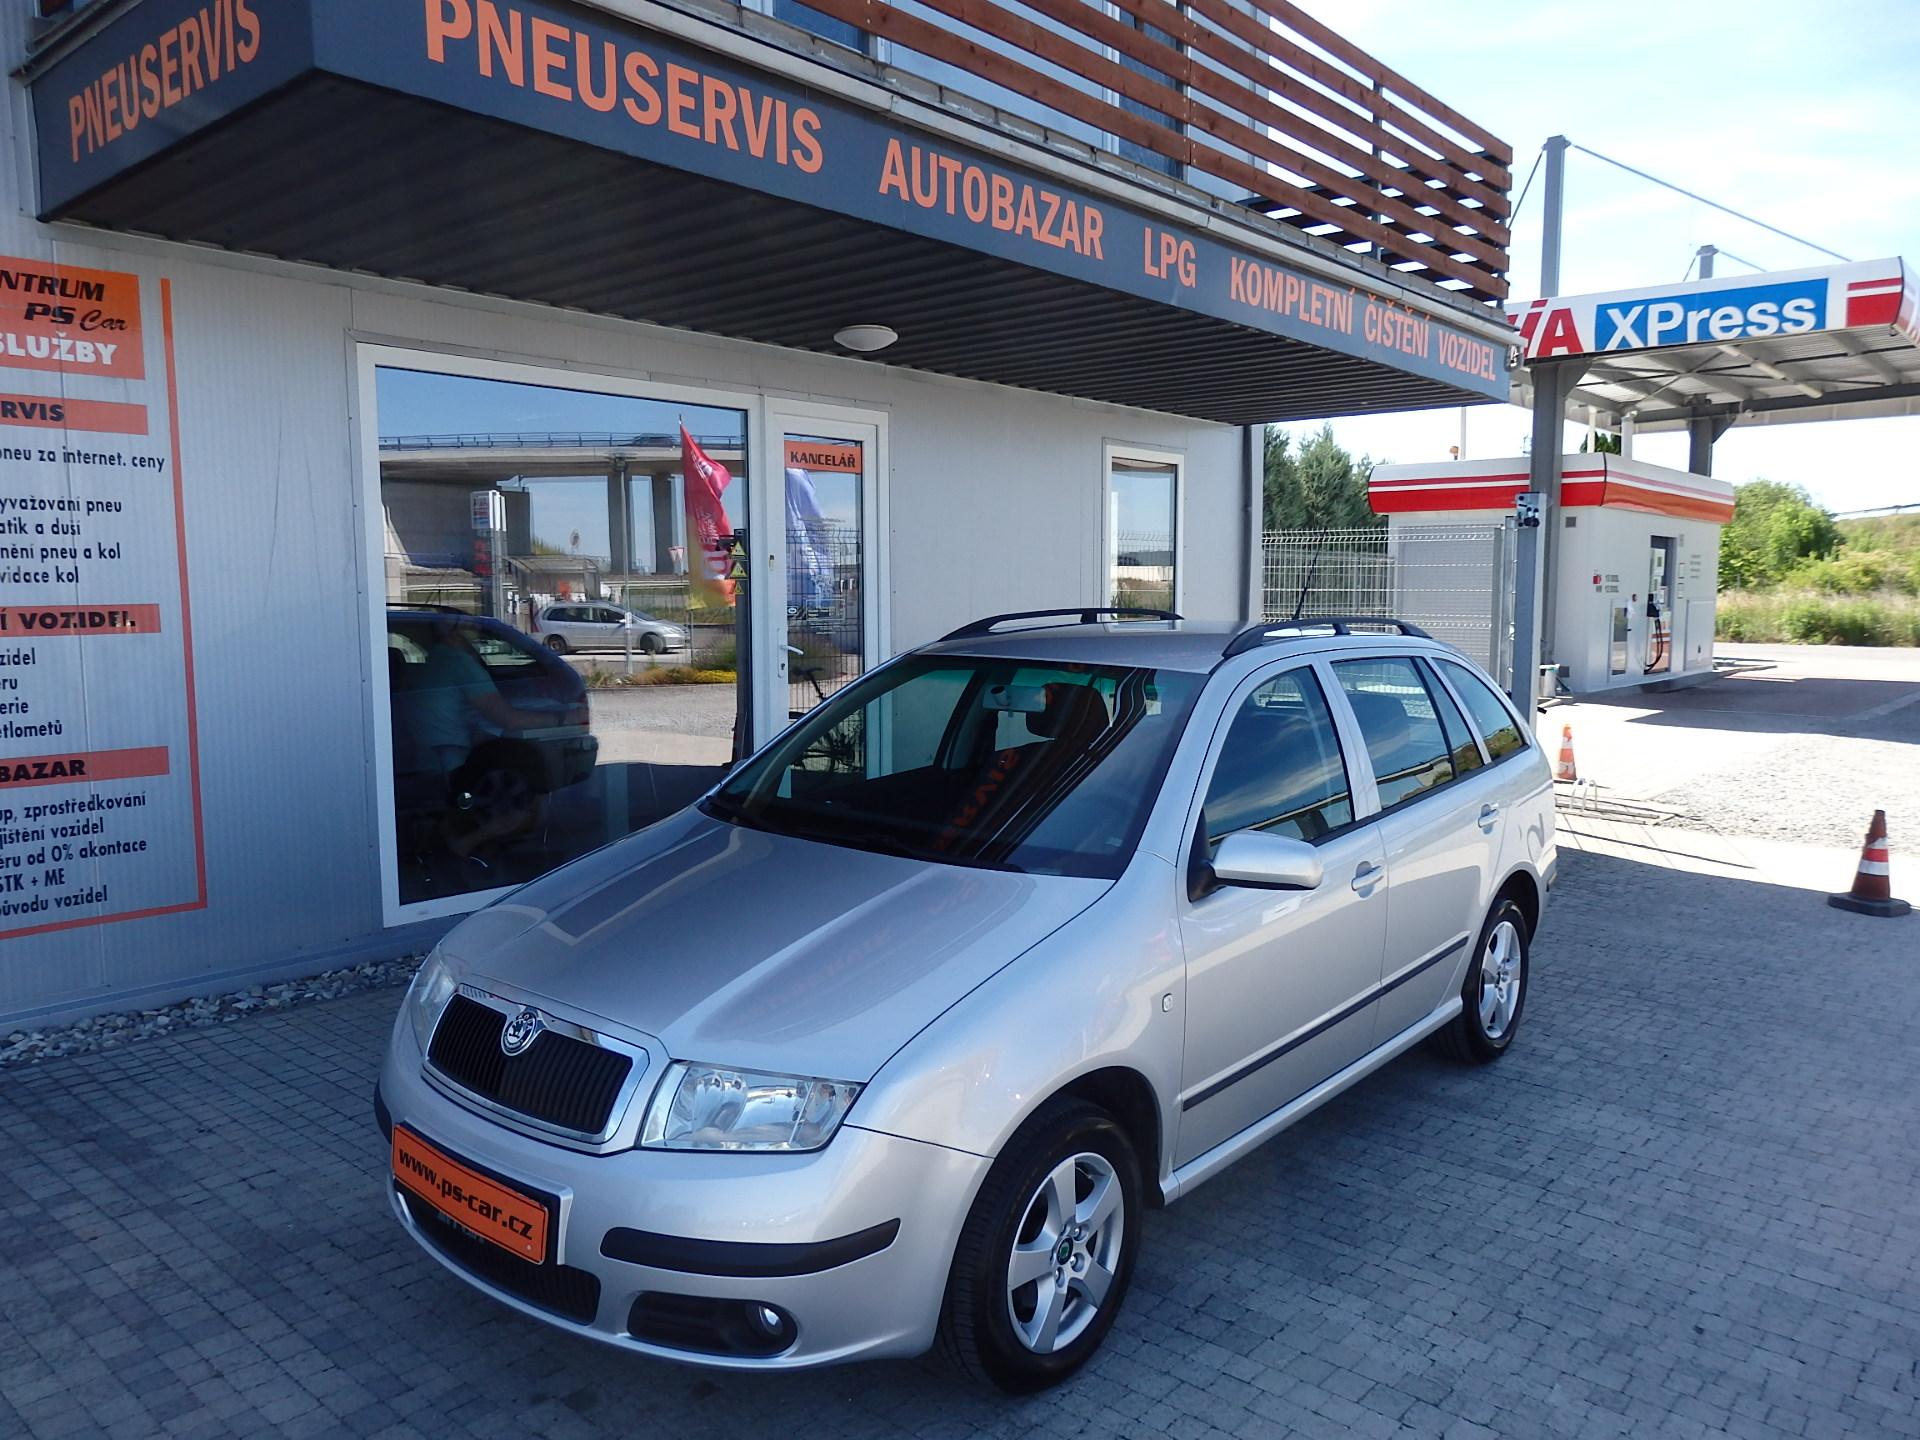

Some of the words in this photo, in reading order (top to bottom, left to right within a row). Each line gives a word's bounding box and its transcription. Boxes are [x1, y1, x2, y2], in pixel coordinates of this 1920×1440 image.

[70, 0, 260, 162] PNEUSERVIS
[425, 0, 823, 174] PNEUSERVIS
[878, 138, 1104, 260] AUTOBAZAR
[1143, 226, 1197, 289] LPG
[1230, 256, 1353, 336] KOMPLETNÍ
[1364, 291, 1431, 360] ČIŠTĚNÍ
[1438, 329, 1497, 382] VOZIDEL
[24, 302, 76, 325] PS
[80, 309, 128, 332] Car
[1605, 296, 1817, 351] XPress
[0, 331, 118, 365] LUŽBY
[0, 447, 31, 461] neu
[38, 449, 56, 462] za
[132, 454, 165, 472] ceny
[790, 450, 856, 468] KANCELÁŘ
[87, 499, 122, 516] pneu
[40, 547, 77, 563] pneu
[84, 548, 92, 559] a
[98, 542, 120, 559] kol
[56, 566, 79, 583] kol
[0, 678, 18, 690] ru
[0, 720, 62, 739] tlometů
[51, 817, 104, 841] vozidel
[27, 847, 45, 866] od
[79, 839, 147, 859] akontace
[44, 868, 66, 887] ME
[0, 895, 48, 916] ůvodu
[54, 885, 108, 909] vozidel
[399, 1148, 533, 1241] www.ps-car.cz
